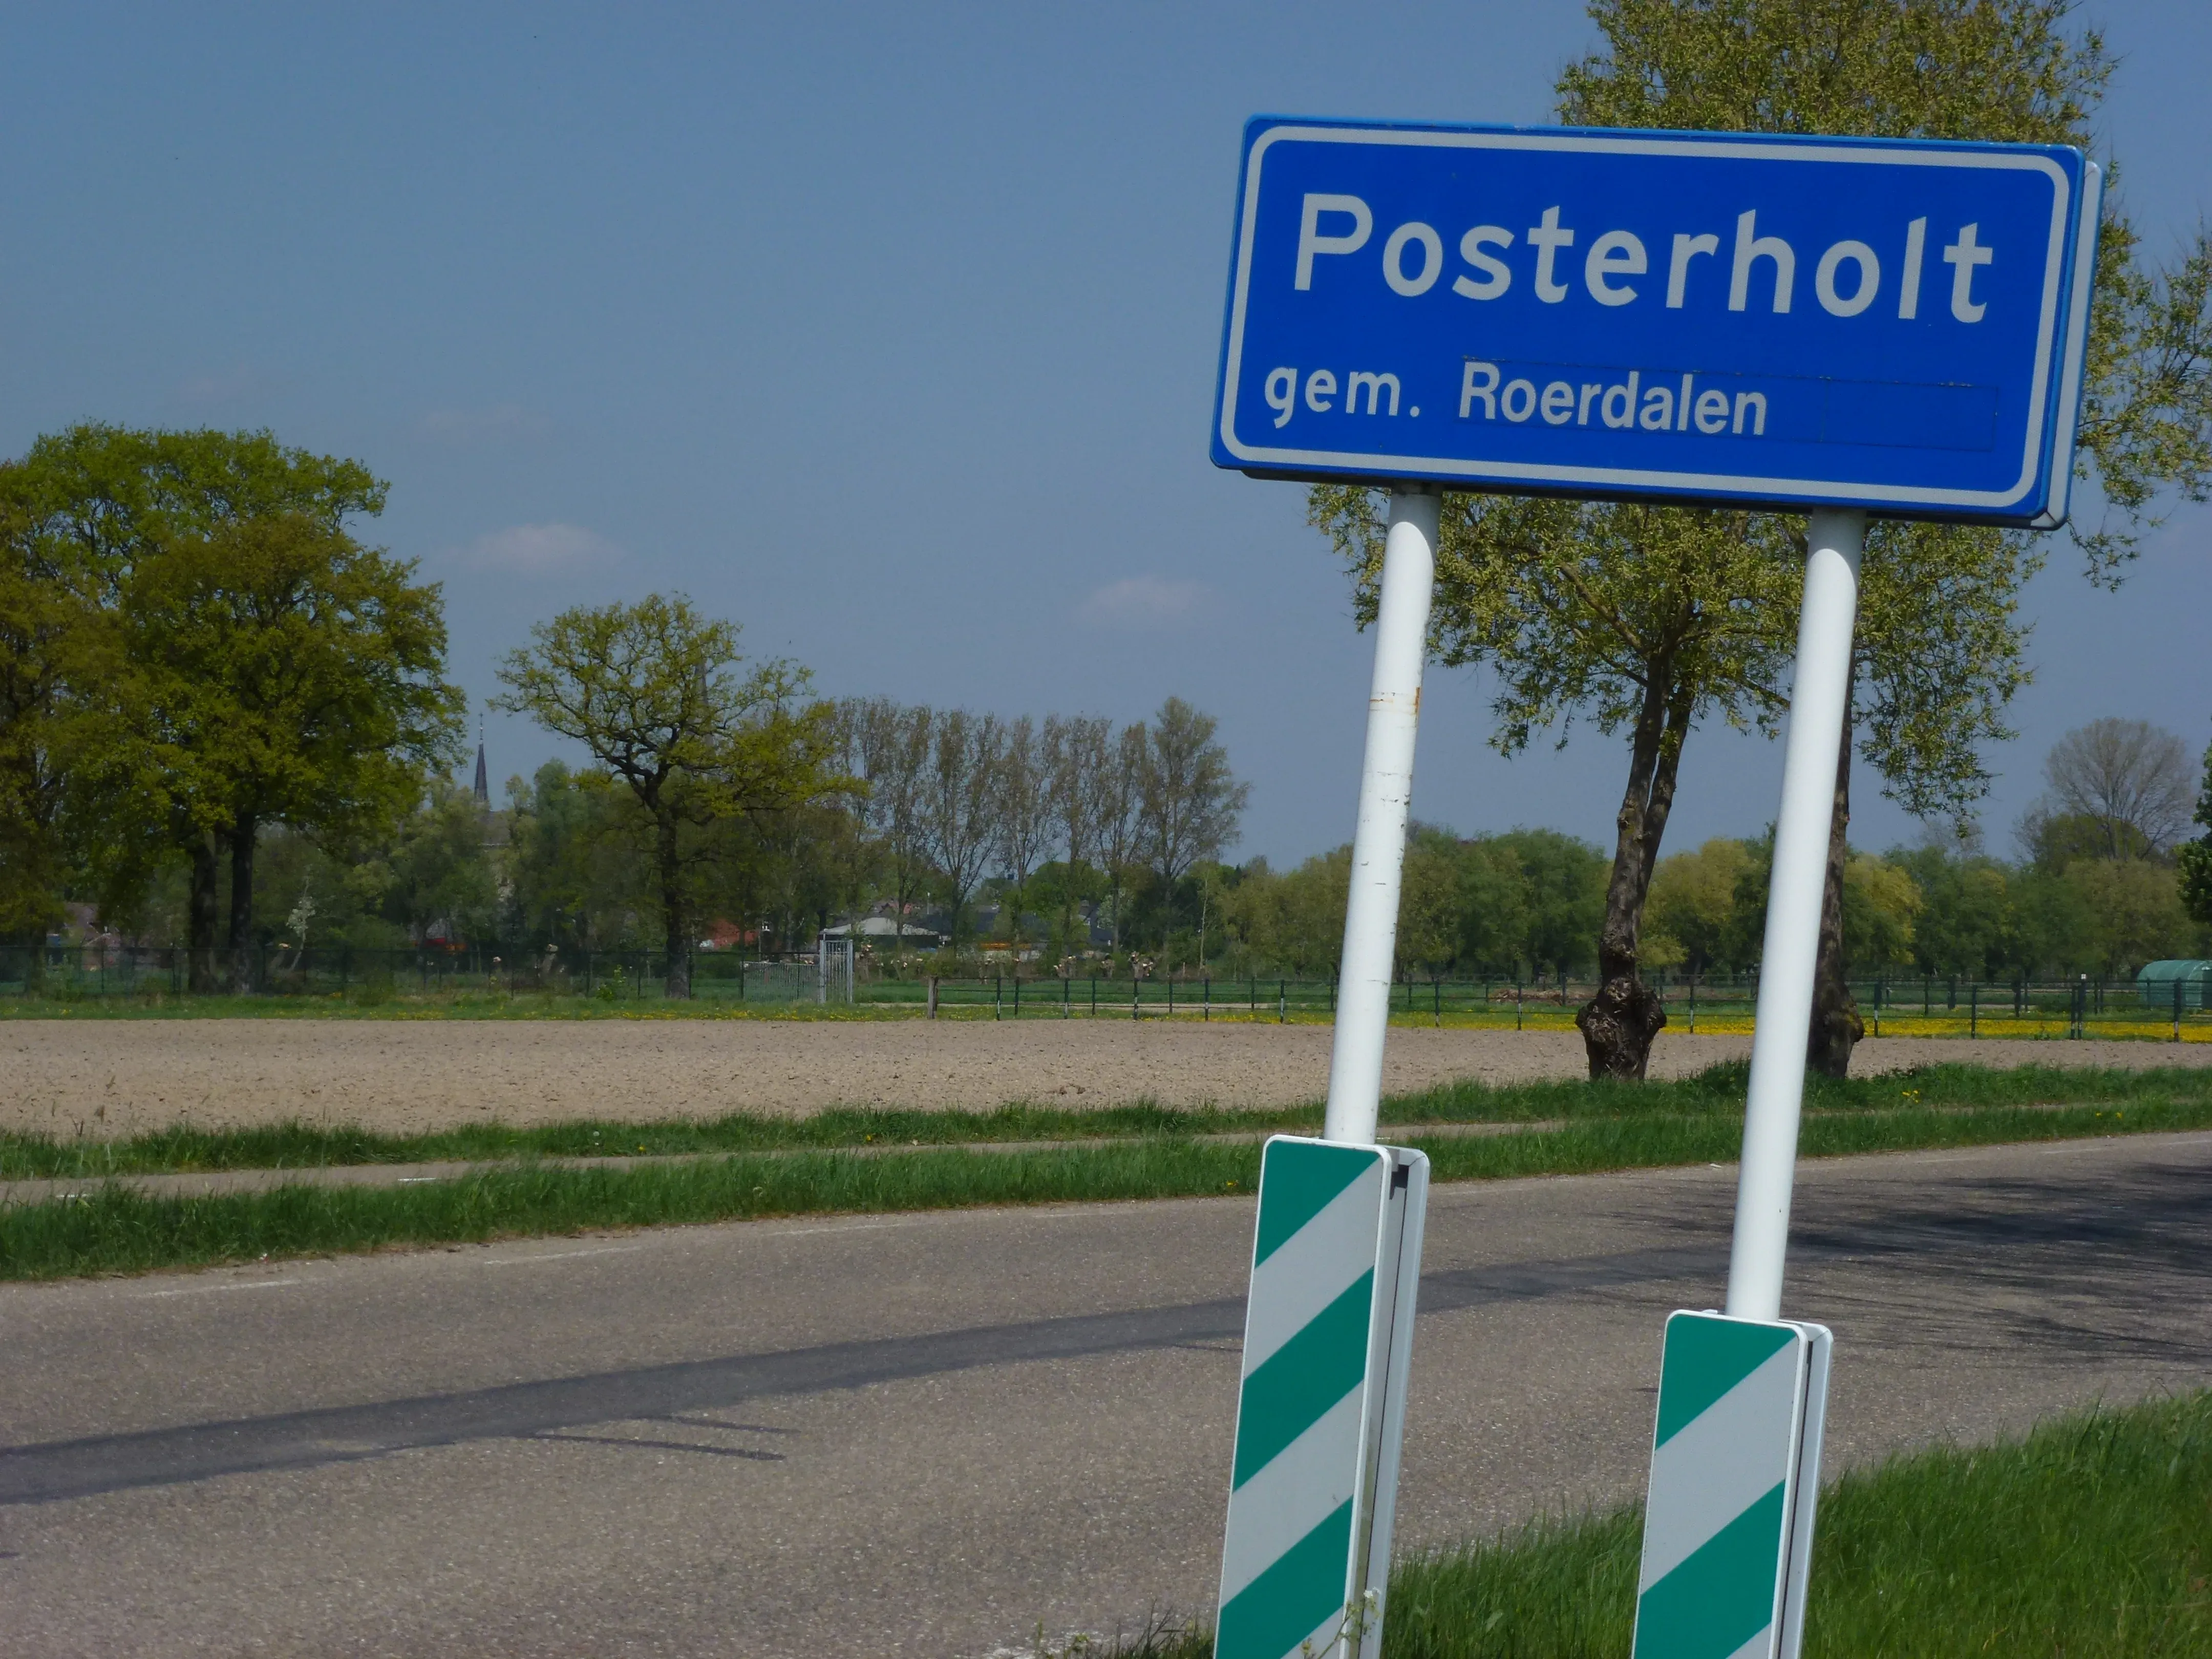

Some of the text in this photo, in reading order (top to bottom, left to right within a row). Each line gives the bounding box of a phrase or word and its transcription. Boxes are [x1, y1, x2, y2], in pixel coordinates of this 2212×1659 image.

[1294, 193, 1993, 324] Posterholt
[1264, 360, 1768, 436] gem. Roerdalen
